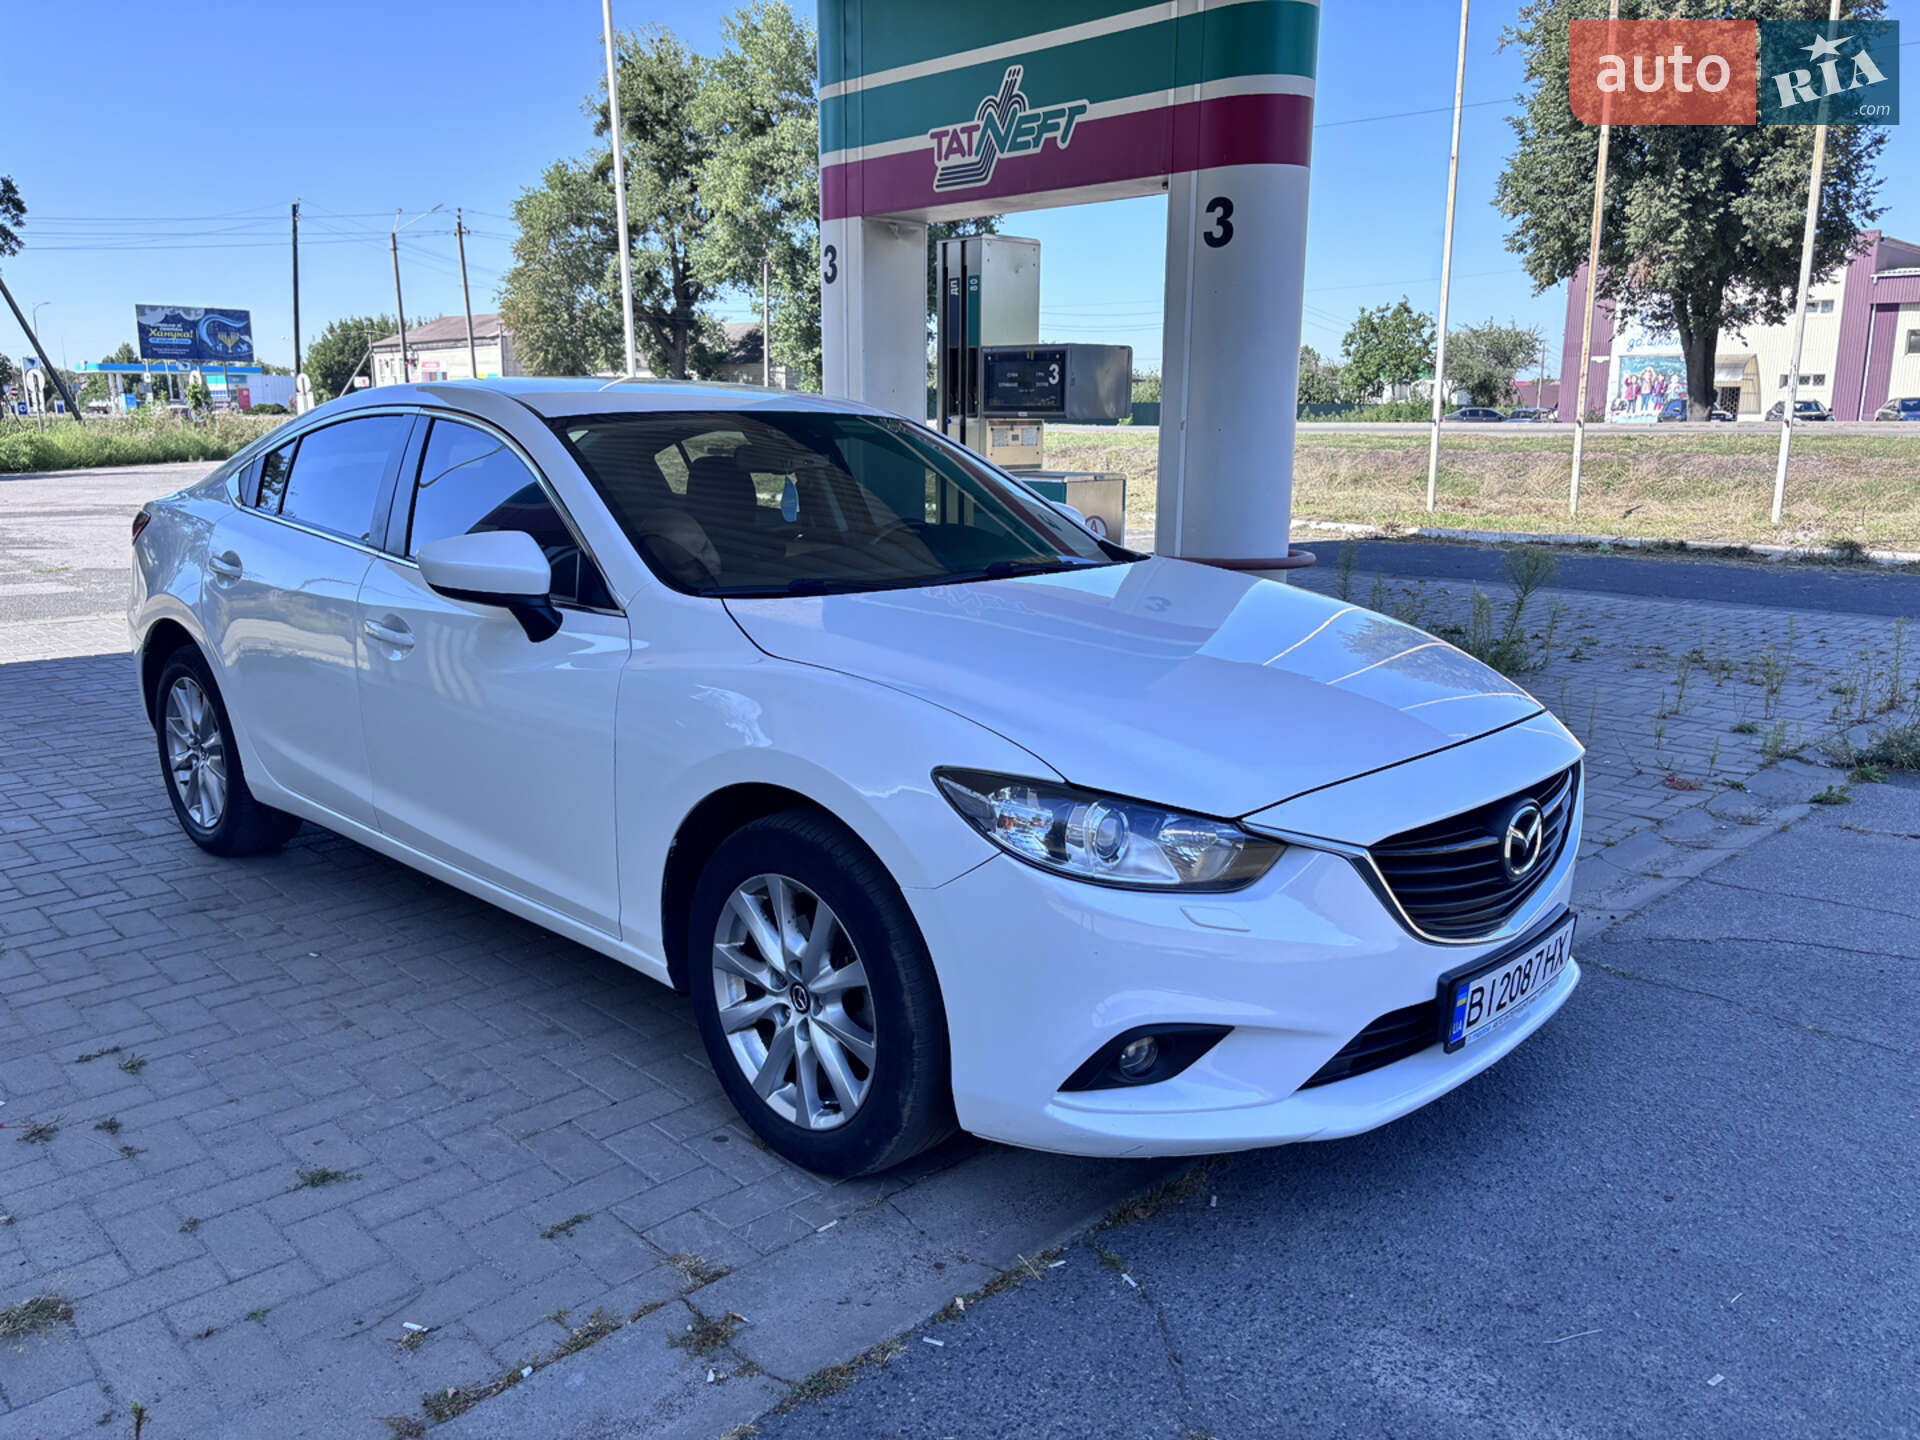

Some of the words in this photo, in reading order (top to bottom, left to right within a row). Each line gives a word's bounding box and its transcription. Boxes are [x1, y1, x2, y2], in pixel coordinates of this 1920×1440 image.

[1203, 196, 1234, 248] 3
[823, 244, 837, 285] 3
[1049, 363, 1060, 385] 3
